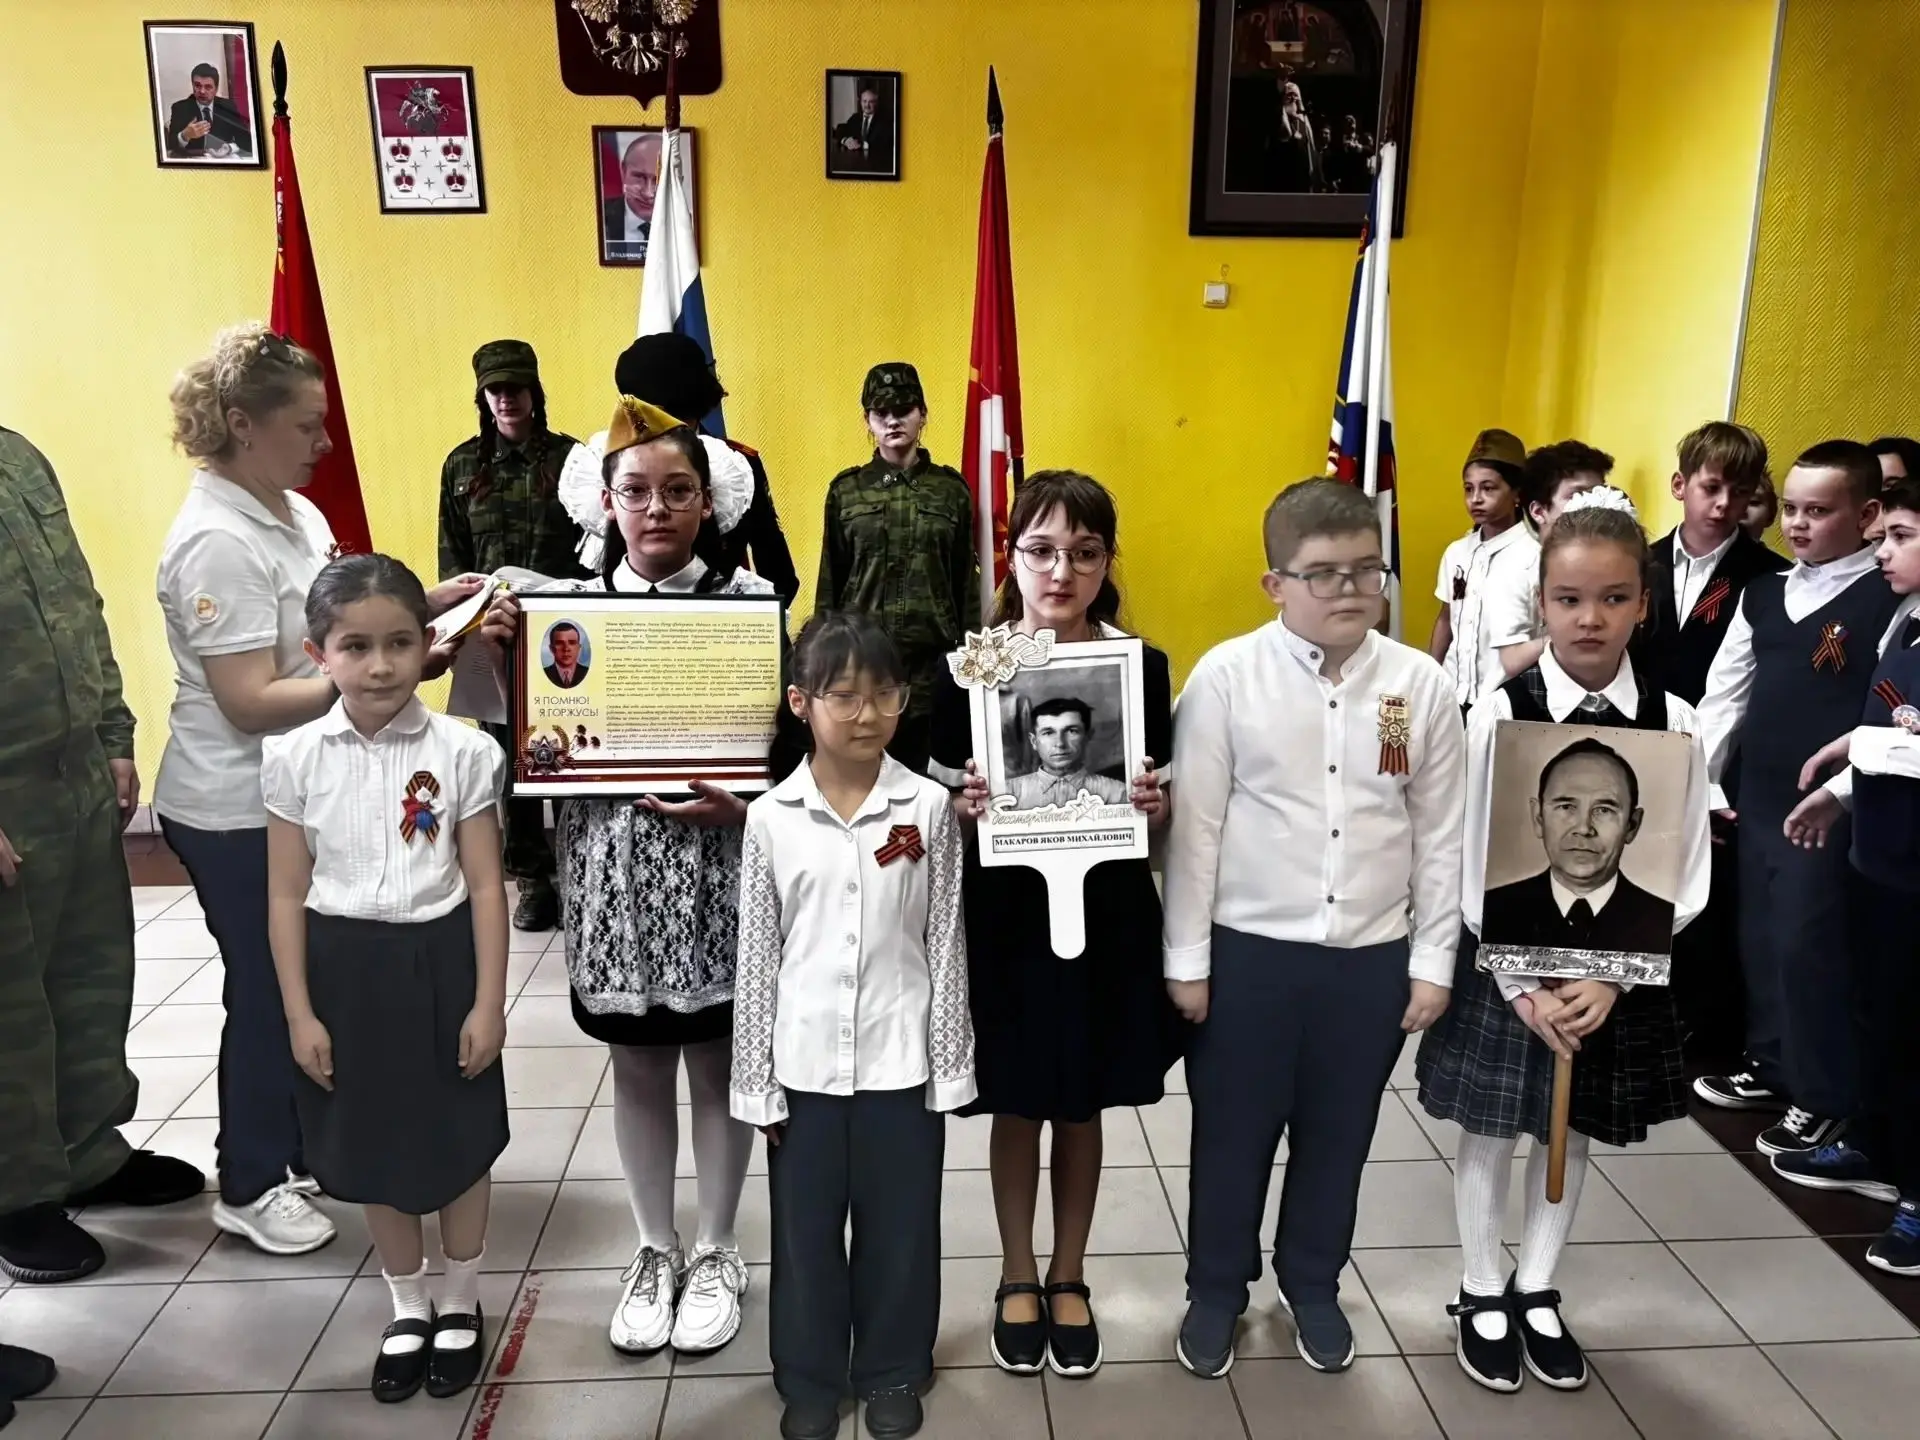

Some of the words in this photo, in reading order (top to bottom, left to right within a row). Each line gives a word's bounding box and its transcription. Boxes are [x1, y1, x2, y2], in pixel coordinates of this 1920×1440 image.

[534, 696, 541, 705] Я
[543, 696, 590, 705] ПОМНЮ!
[539, 708, 546, 717] Я
[547, 708, 599, 717] ГОРЖУСЬ!
[995, 836, 1039, 847] МАКАРОВ
[1040, 834, 1066, 845] ЯКОВ
[1067, 832, 1133, 844] МИХАЙЛОВИЧ
